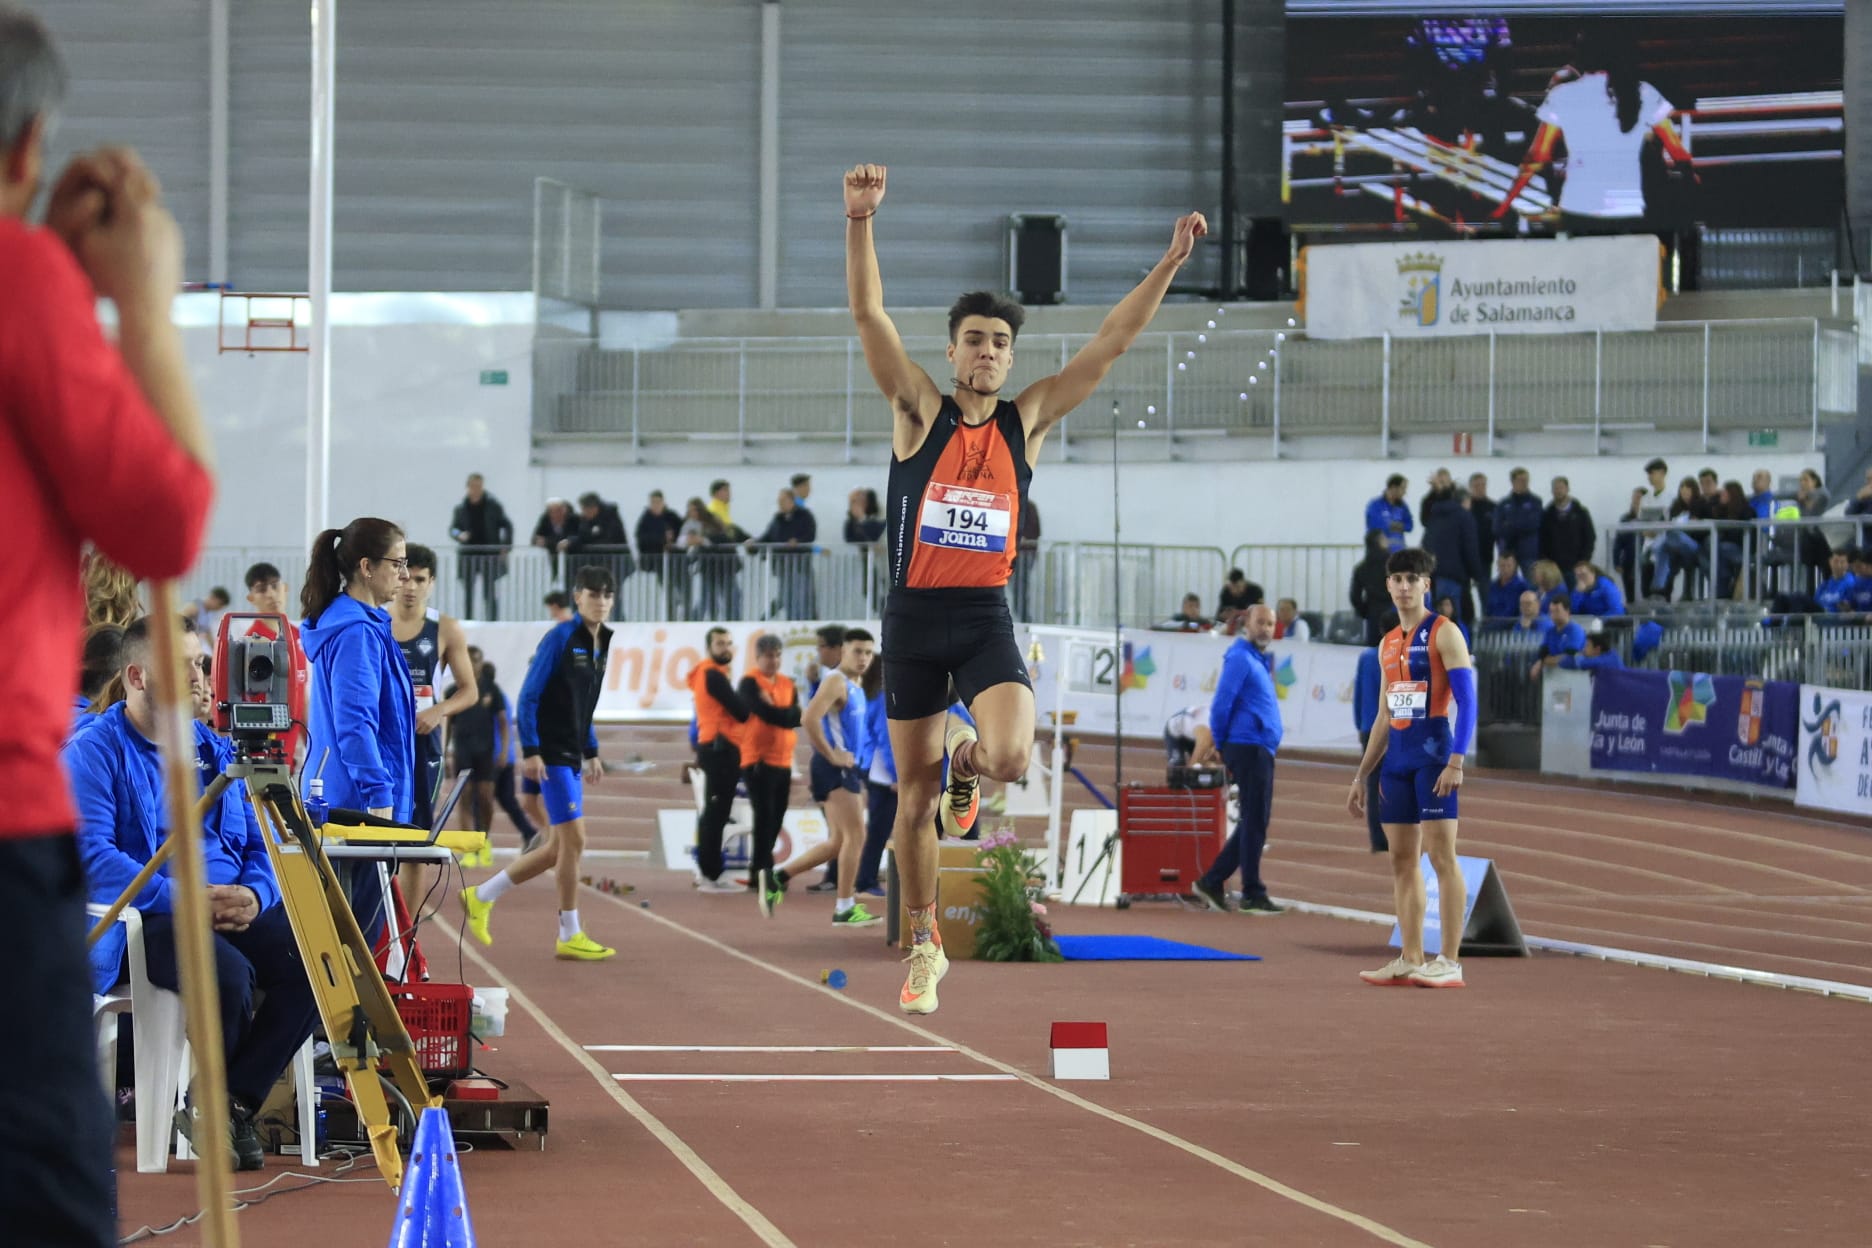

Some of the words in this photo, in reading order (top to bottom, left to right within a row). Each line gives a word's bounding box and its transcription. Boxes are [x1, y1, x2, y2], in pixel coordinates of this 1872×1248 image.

[1450, 276, 1576, 301] Ayuntamiento
[1450, 303, 1470, 324] de
[1476, 302, 1575, 323] Salamanca
[946, 508, 988, 531] 194
[939, 531, 988, 548] Joma
[1096, 648, 1114, 685] 2
[1394, 694, 1413, 706] 236
[1595, 711, 1629, 730] Junta
[1632, 714, 1646, 731] de
[1607, 736, 1615, 755] y
[1618, 733, 1645, 752] León
[1077, 833, 1086, 874] 1
